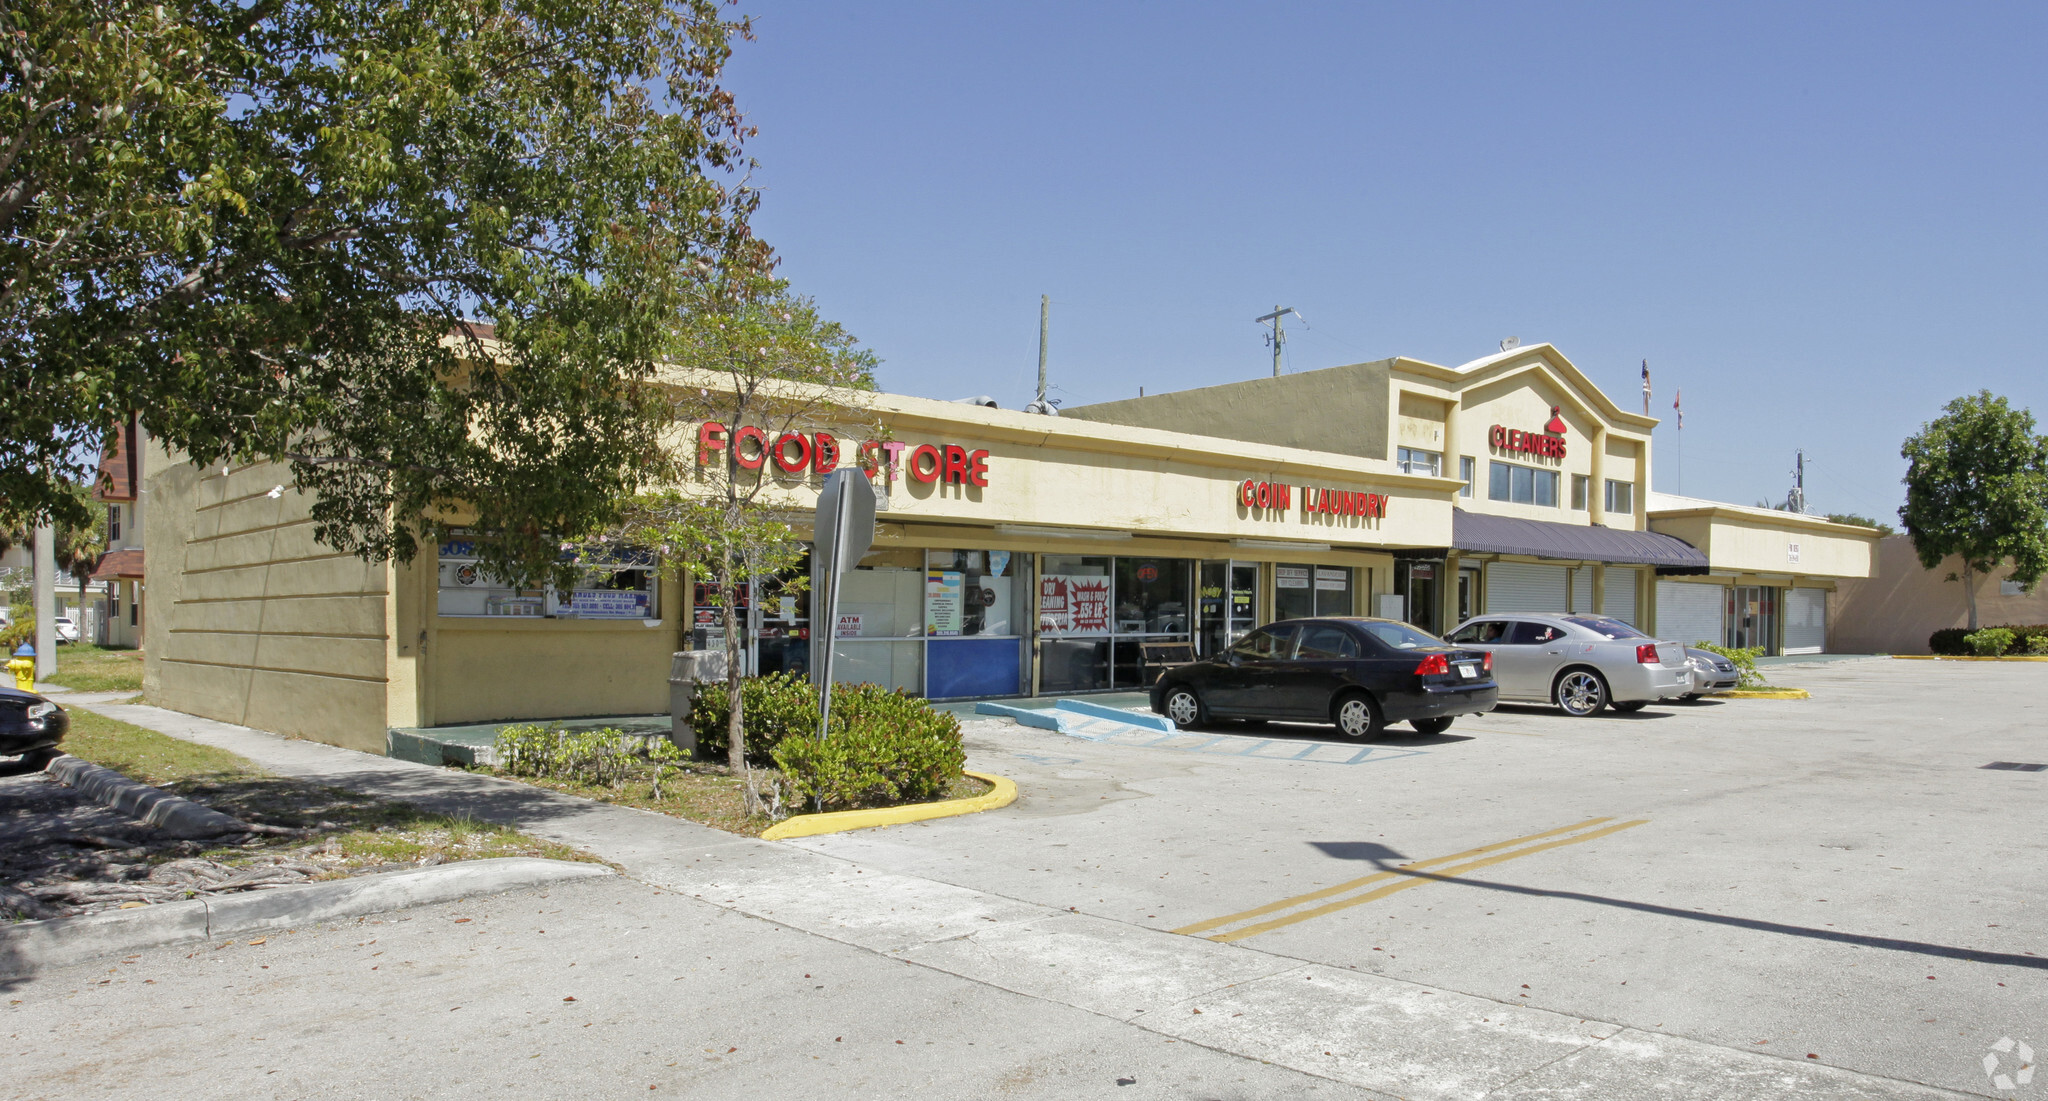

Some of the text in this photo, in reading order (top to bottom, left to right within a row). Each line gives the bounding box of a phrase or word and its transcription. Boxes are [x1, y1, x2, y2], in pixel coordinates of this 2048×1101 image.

[699, 421, 989, 488] FOOD STORE
[1490, 423, 1567, 459] CLEANERS
[1241, 478, 1389, 519] COIN LAUNDRY
[694, 583, 749, 607] OPN
[1044, 582, 1056, 595] DRY
[1076, 591, 1090, 601] WASH
[1094, 591, 1106, 601] FOLD
